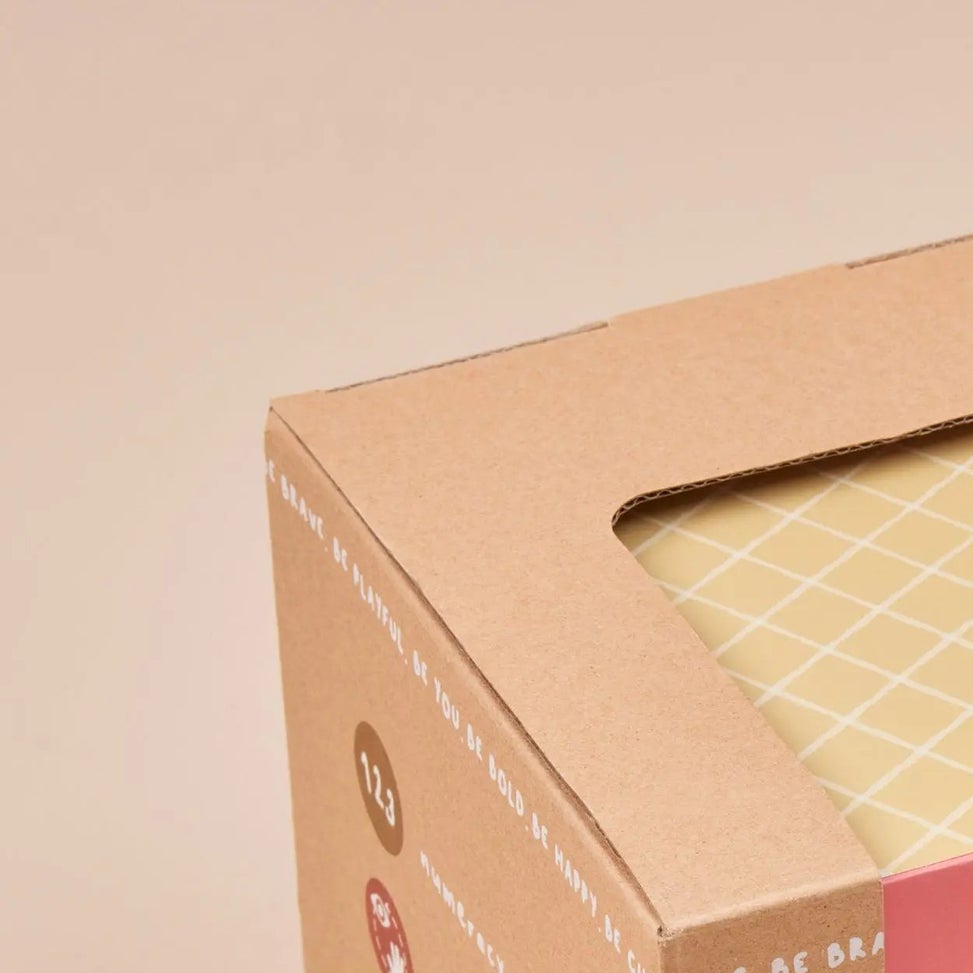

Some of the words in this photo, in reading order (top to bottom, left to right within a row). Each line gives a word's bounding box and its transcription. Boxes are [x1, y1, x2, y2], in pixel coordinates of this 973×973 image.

[333, 536, 348, 571] BE
[352, 563, 407, 664] PLAYFUL.
[412, 650, 428, 685] BE
[467, 723, 483, 761] BE
[531, 812, 549, 849] BE
[604, 914, 622, 954] BE
